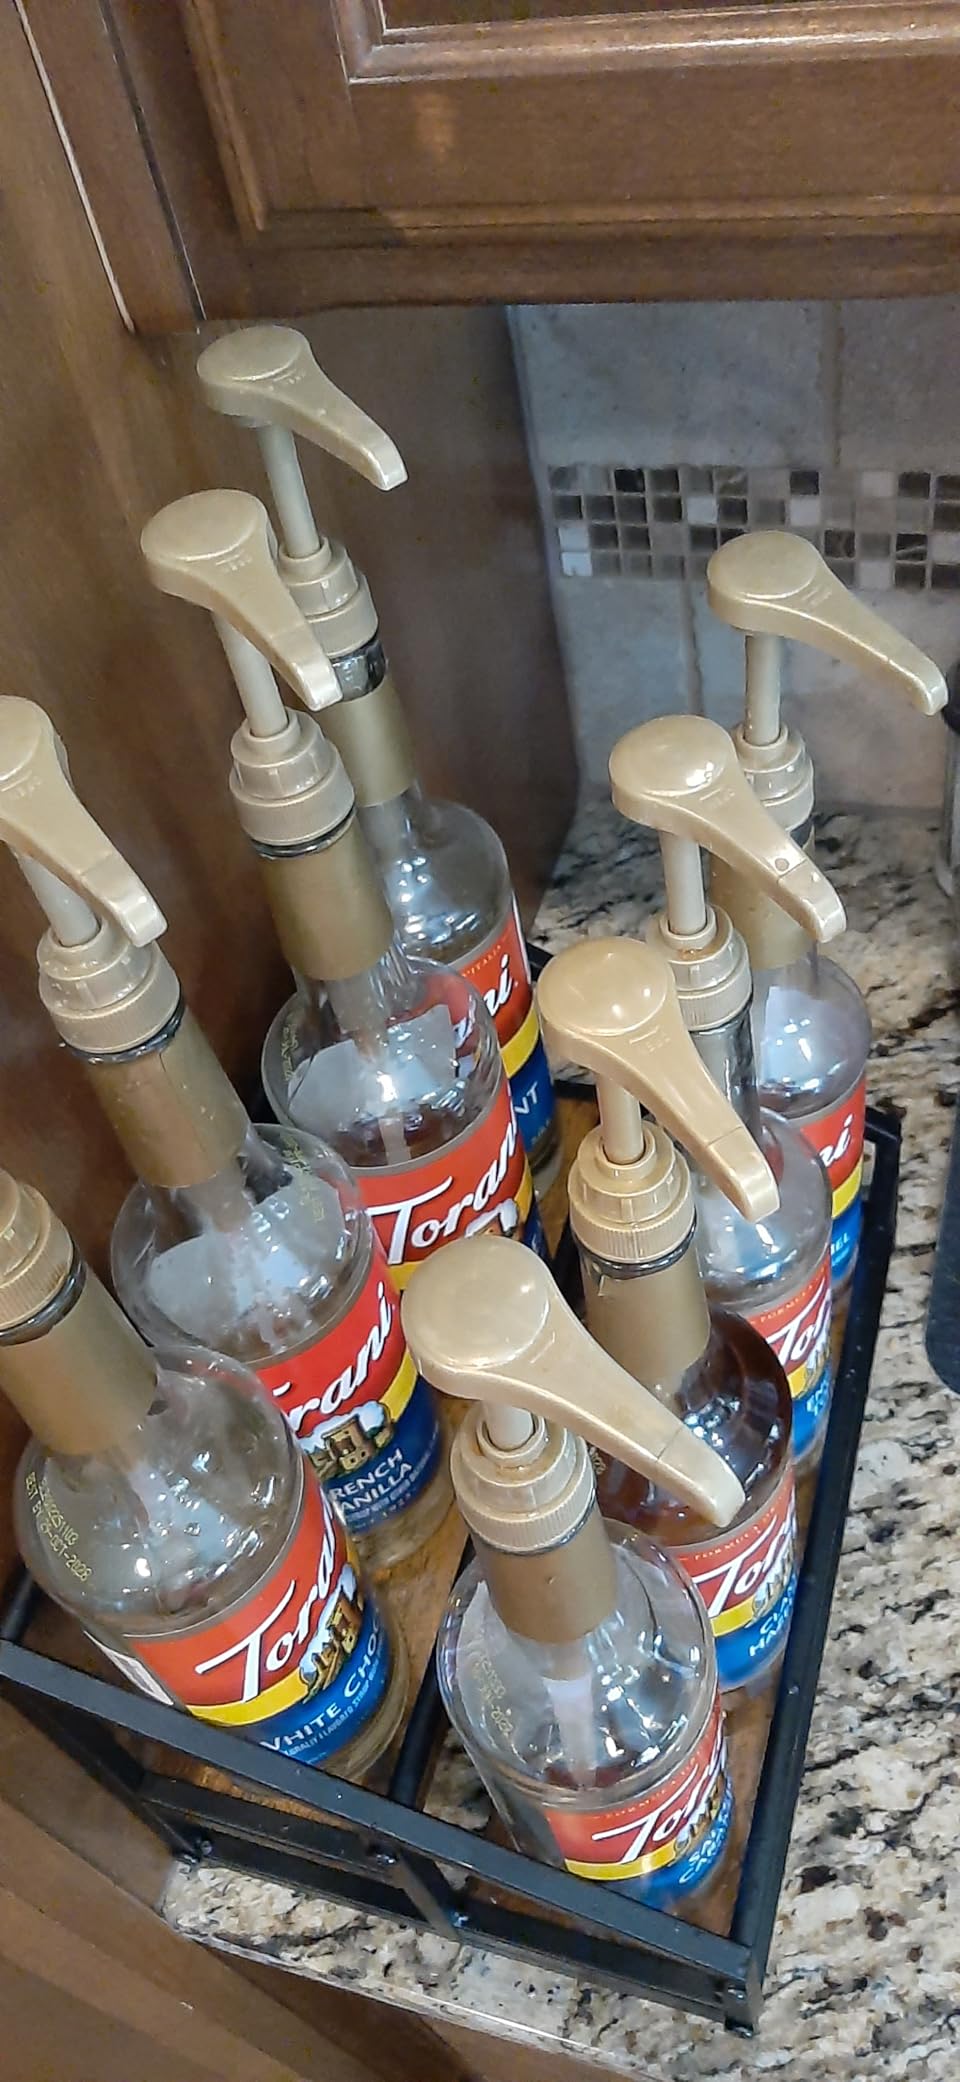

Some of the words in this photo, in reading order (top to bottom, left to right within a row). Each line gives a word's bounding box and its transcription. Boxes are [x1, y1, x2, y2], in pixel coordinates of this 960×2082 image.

[366, 1081, 517, 1265] Toran
[272, 1281, 393, 1432] rani
[330, 1449, 404, 1502] RENCH
[340, 1463, 412, 1513] ANILLA
